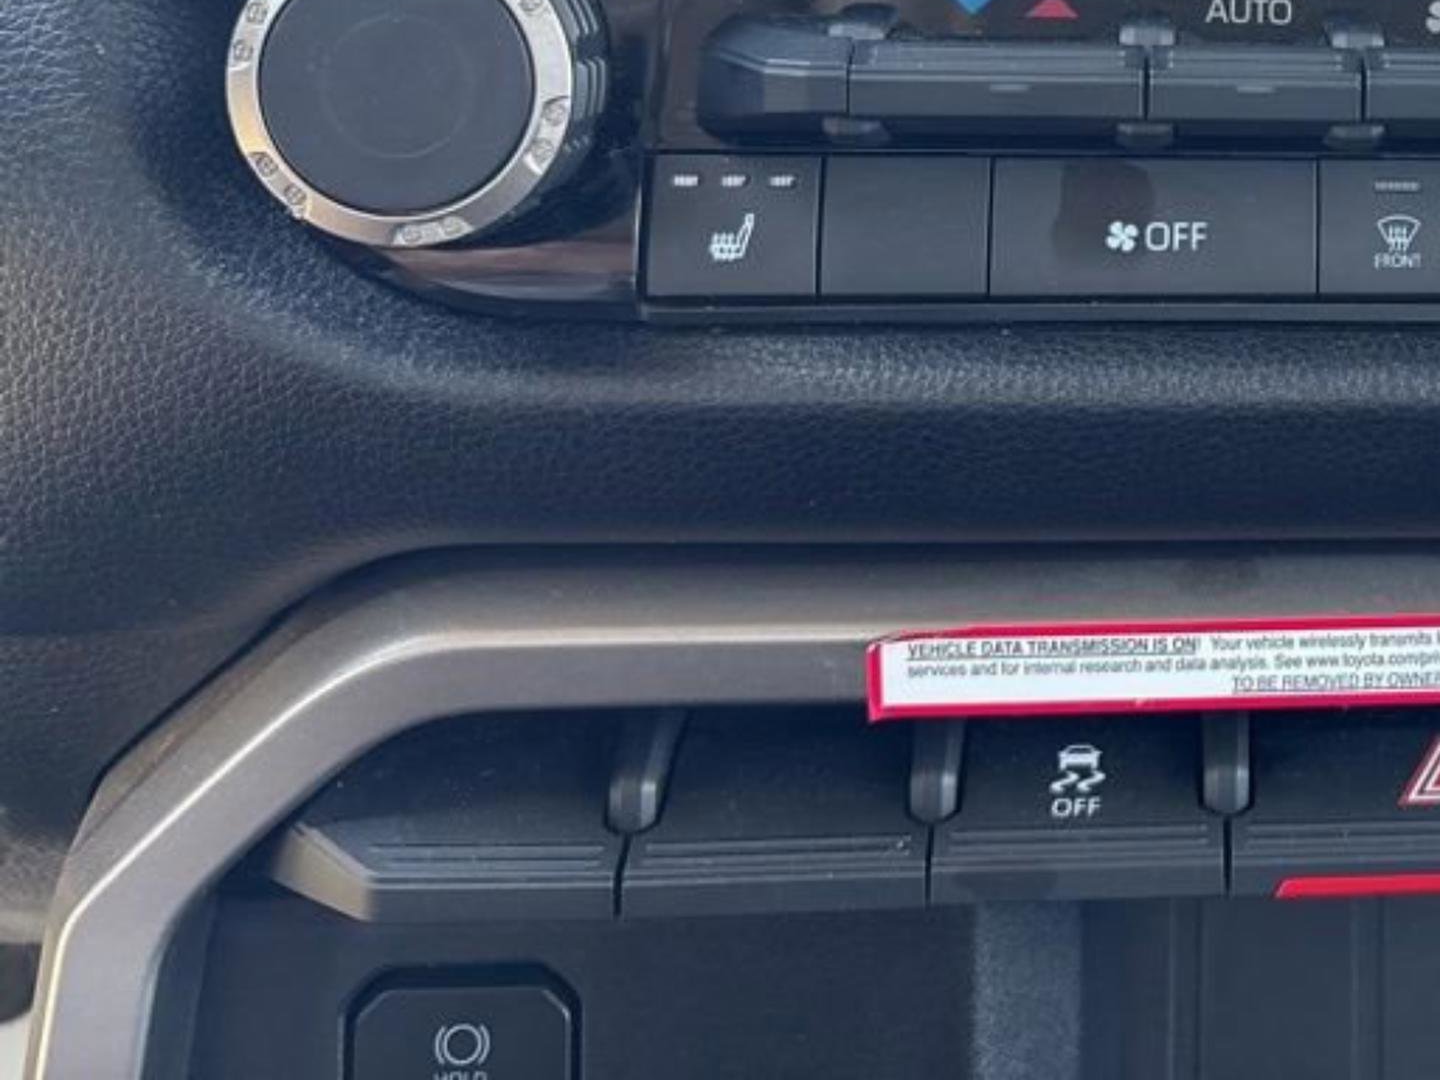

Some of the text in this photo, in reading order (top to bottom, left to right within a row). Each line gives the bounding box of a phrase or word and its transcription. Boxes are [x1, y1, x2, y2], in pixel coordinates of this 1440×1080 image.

[1145, 222, 1207, 252] OFF
[1374, 253, 1421, 269] FRONT
[907, 643, 976, 660] VEHICLE
[981, 640, 1024, 656] DATA
[1027, 637, 1148, 655] TRANSMISSION
[1151, 638, 1169, 652] IS
[1209, 635, 1242, 651] Your
[1245, 634, 1294, 650] vehicle
[1298, 632, 1366, 650] wirelessly
[1369, 631, 1432, 648] transmits
[908, 662, 966, 678] services
[970, 660, 997, 676] and
[1000, 659, 1020, 675] for
[1023, 658, 1077, 675] internal
[1080, 656, 1141, 674] research
[1145, 655, 1172, 671] and
[1175, 653, 1206, 670] data
[1209, 654, 1267, 673] analysis.
[1273, 653, 1301, 669] See
[1233, 675, 1254, 692] TO
[1256, 674, 1278, 691] BE
[1281, 672, 1359, 691] REMOVED
[1362, 672, 1385, 688] BY
[1050, 798, 1102, 817] OFF
